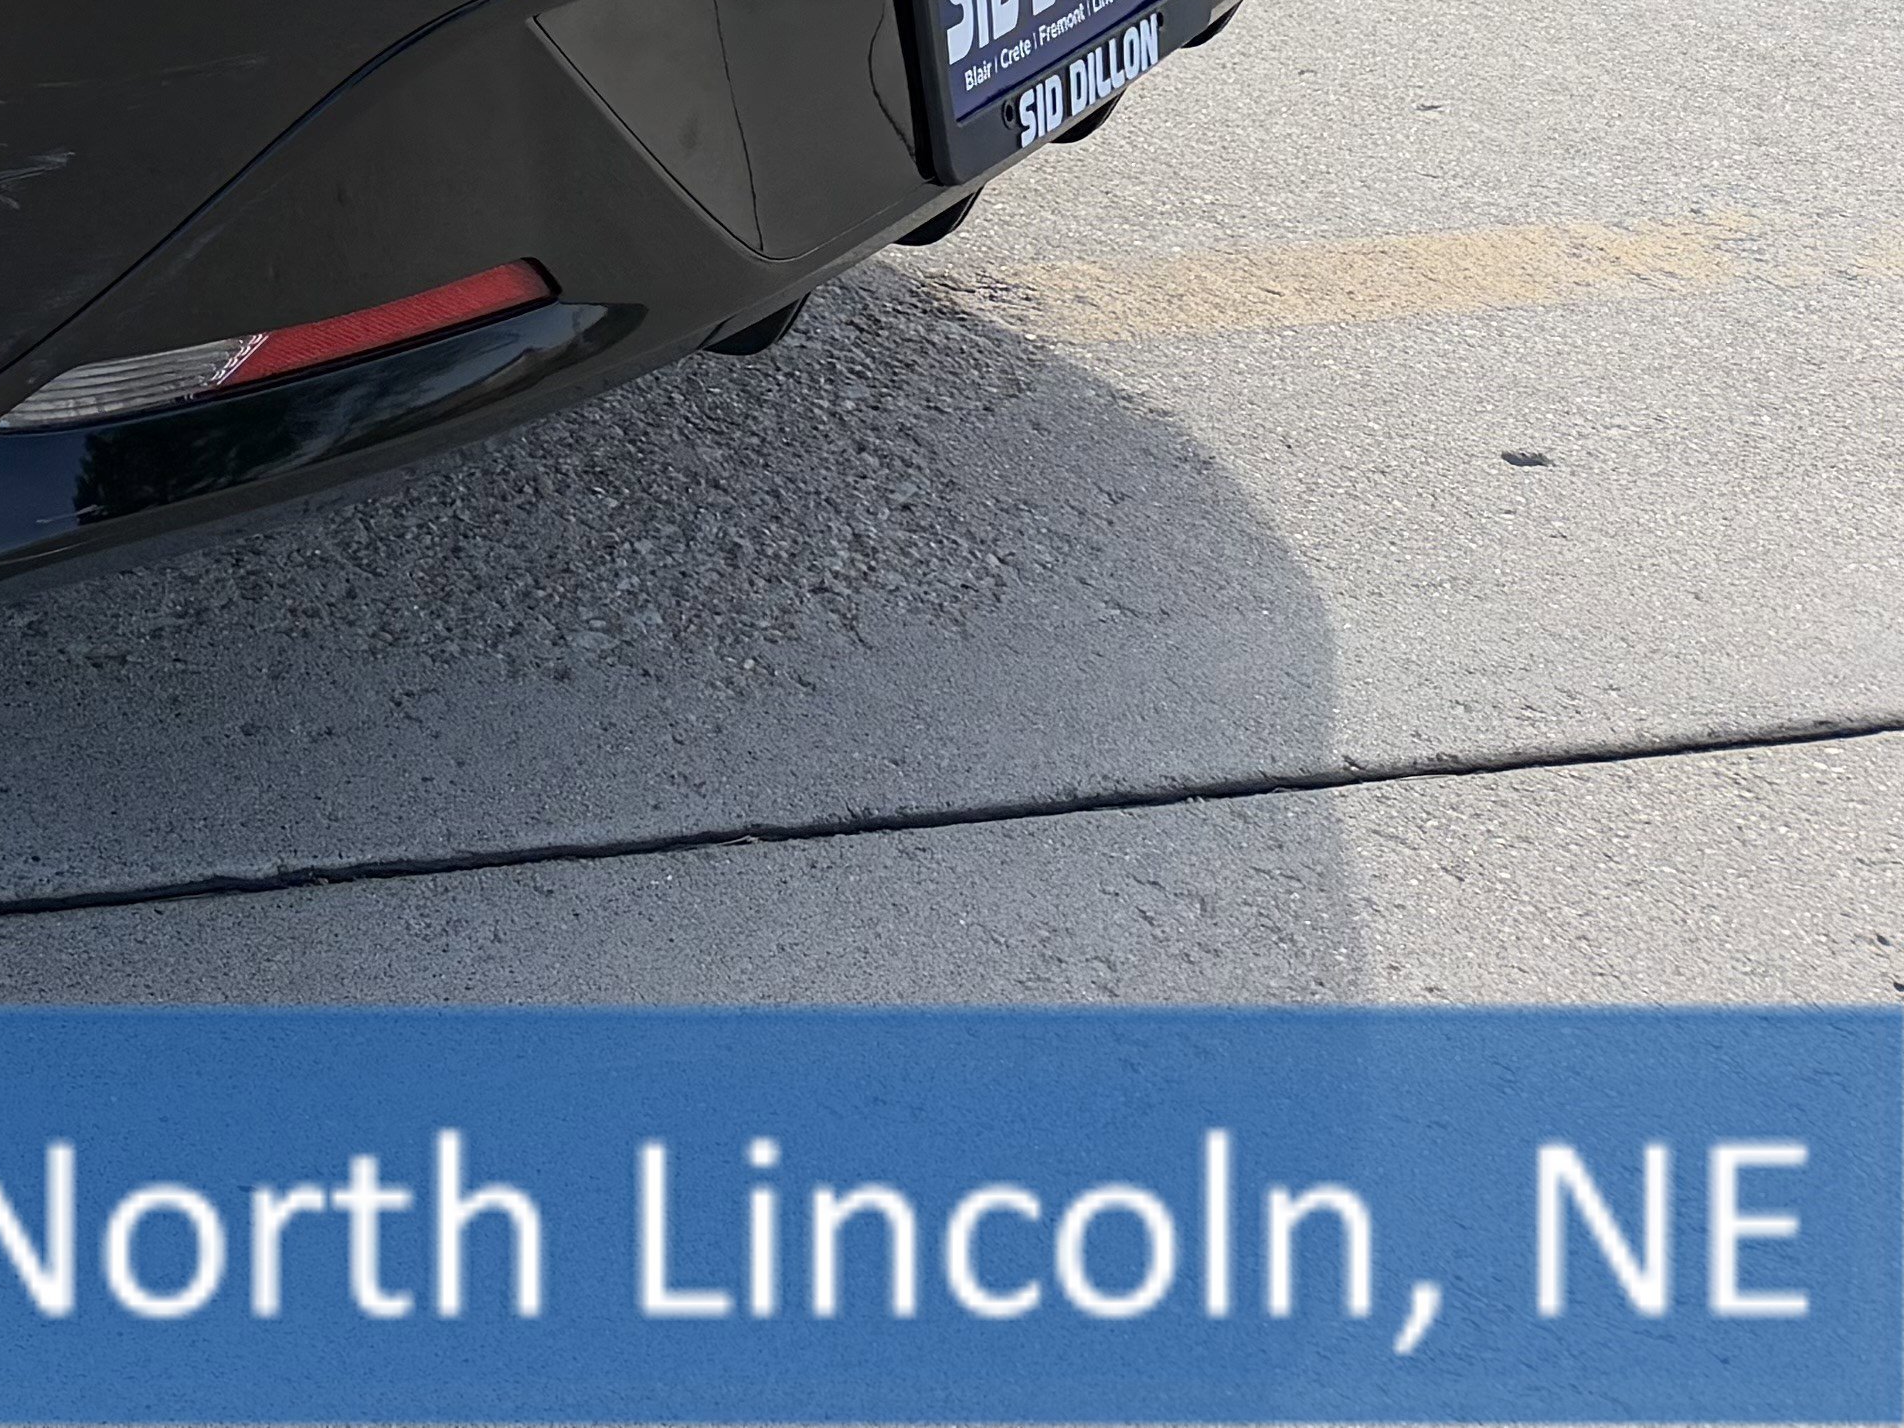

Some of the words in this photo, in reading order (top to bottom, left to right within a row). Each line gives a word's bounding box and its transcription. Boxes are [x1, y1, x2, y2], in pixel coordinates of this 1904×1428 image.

[964, 60, 993, 92] Blair
[1000, 37, 1032, 70] Crete
[1039, 2, 1086, 47] Fremont
[1018, 74, 1063, 149] SID
[1069, 12, 1160, 117] DILLON
